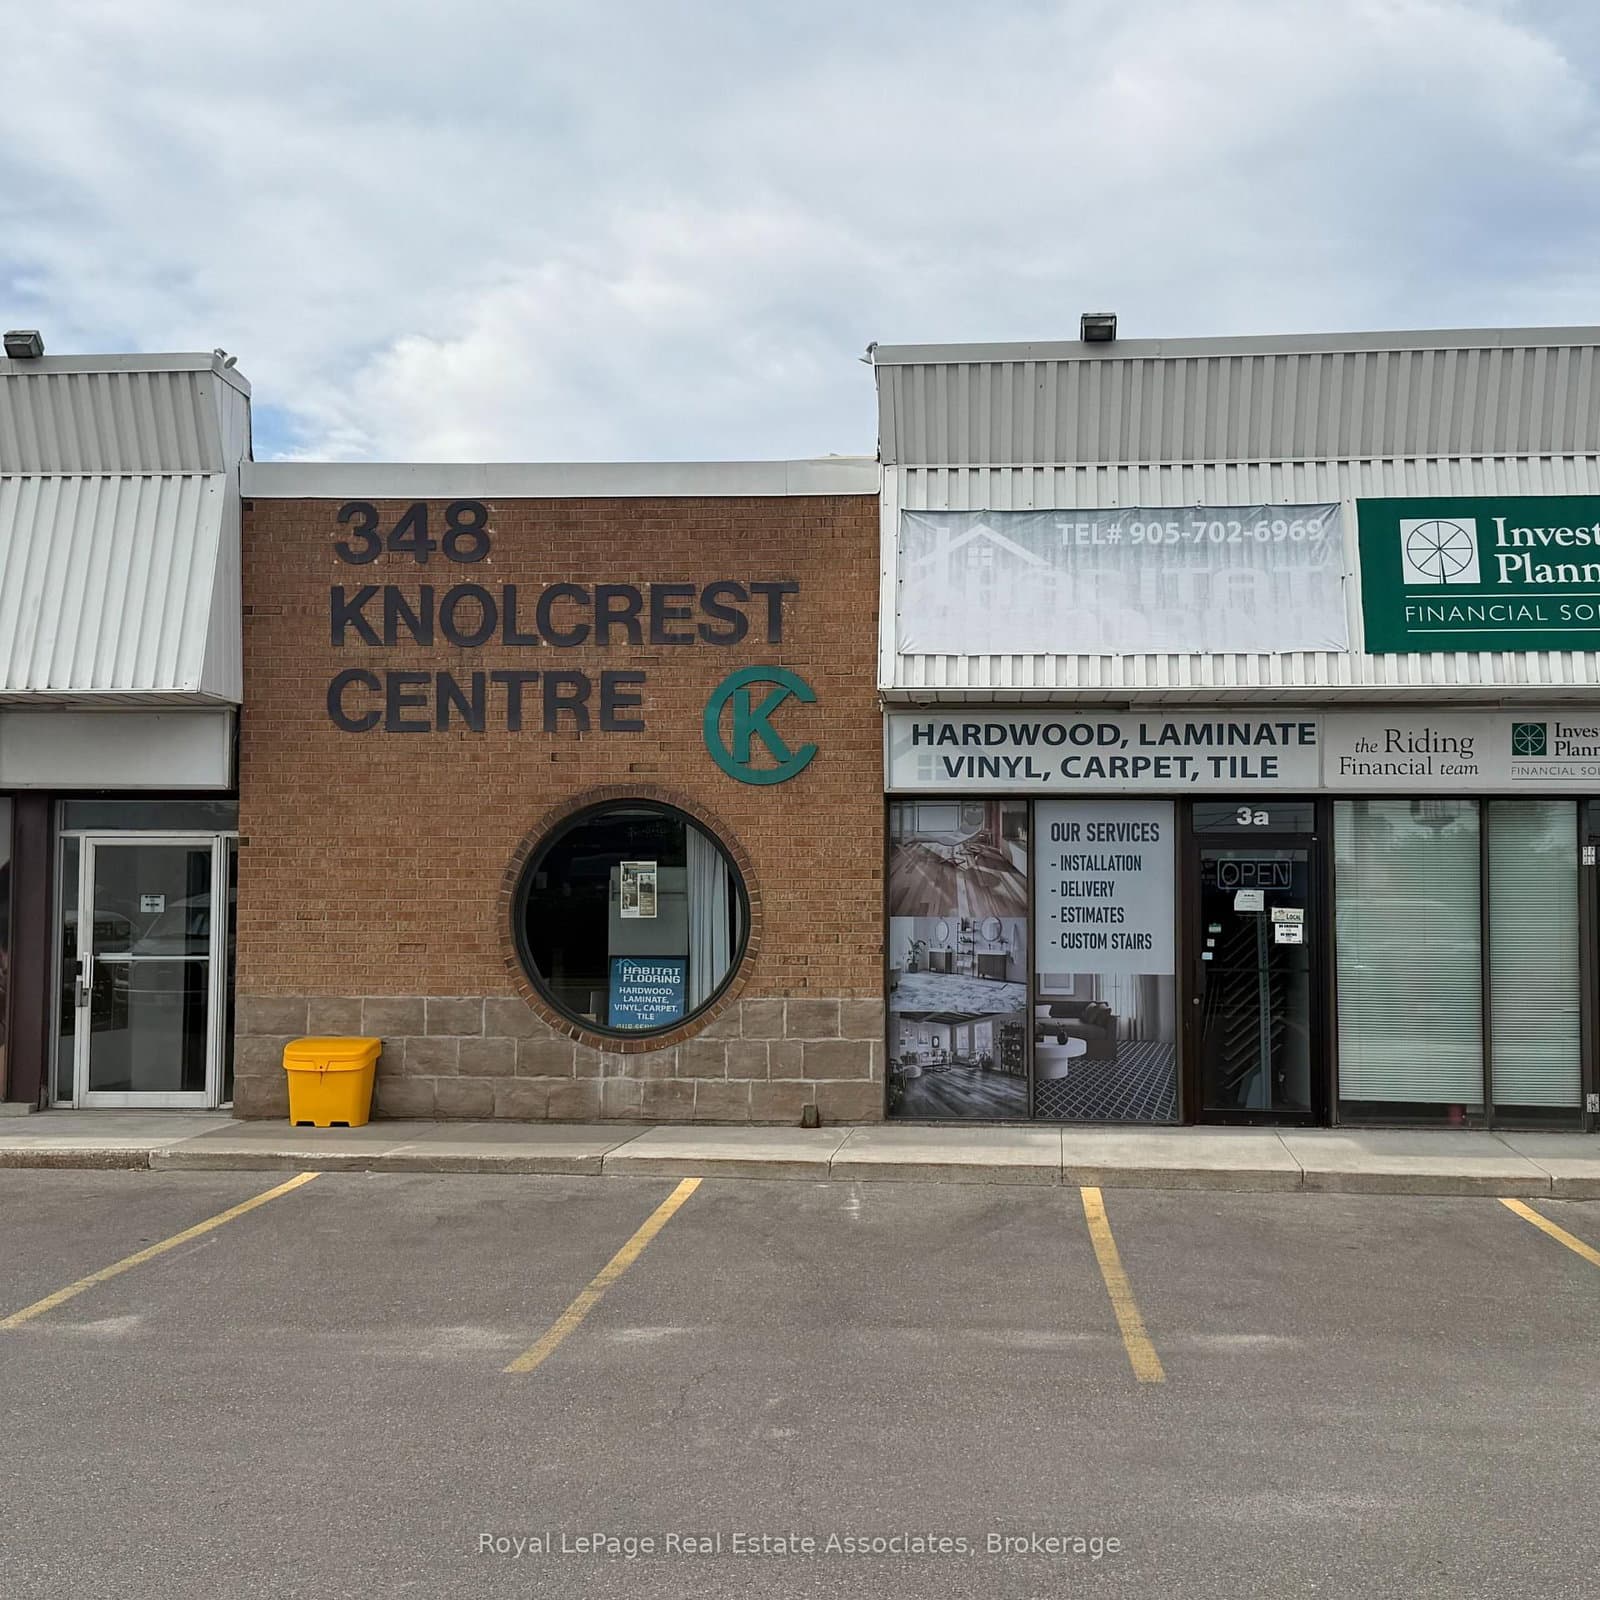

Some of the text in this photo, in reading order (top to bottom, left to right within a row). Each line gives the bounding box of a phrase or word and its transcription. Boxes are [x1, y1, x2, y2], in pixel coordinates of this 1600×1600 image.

[334, 500, 491, 565] 348
[1057, 519, 1326, 545] TEL# 905-702-6969
[330, 580, 800, 648] KNOLCREST
[1405, 604, 1600, 622] FINANCIAL SO
[327, 668, 646, 733] CENTRE
[912, 722, 1317, 749] HARDWOOD, LAMINATE
[1355, 728, 1475, 759] the Riding
[943, 755, 1279, 781] VINYL, CARPET, TILE
[1339, 756, 1479, 775] Financial team
[1511, 766, 1600, 776] FINANCIAL SO
[1236, 807, 1270, 826] 3a
[1050, 822, 1160, 842] OUR SERVICES
[1060, 854, 1142, 872] INSTALLATION
[1221, 863, 1289, 885] OPEN
[1060, 880, 1115, 897] DELIVERY
[1060, 906, 1125, 923] ESTIMATES
[1060, 932, 1108, 950] CUSTOM
[1111, 933, 1153, 950] STAIRS
[623, 966, 681, 975] HABITAT
[623, 974, 681, 984] FLOORING
[619, 986, 674, 996] HARDWOOD,
[636, 1012, 655, 1020] TILE
